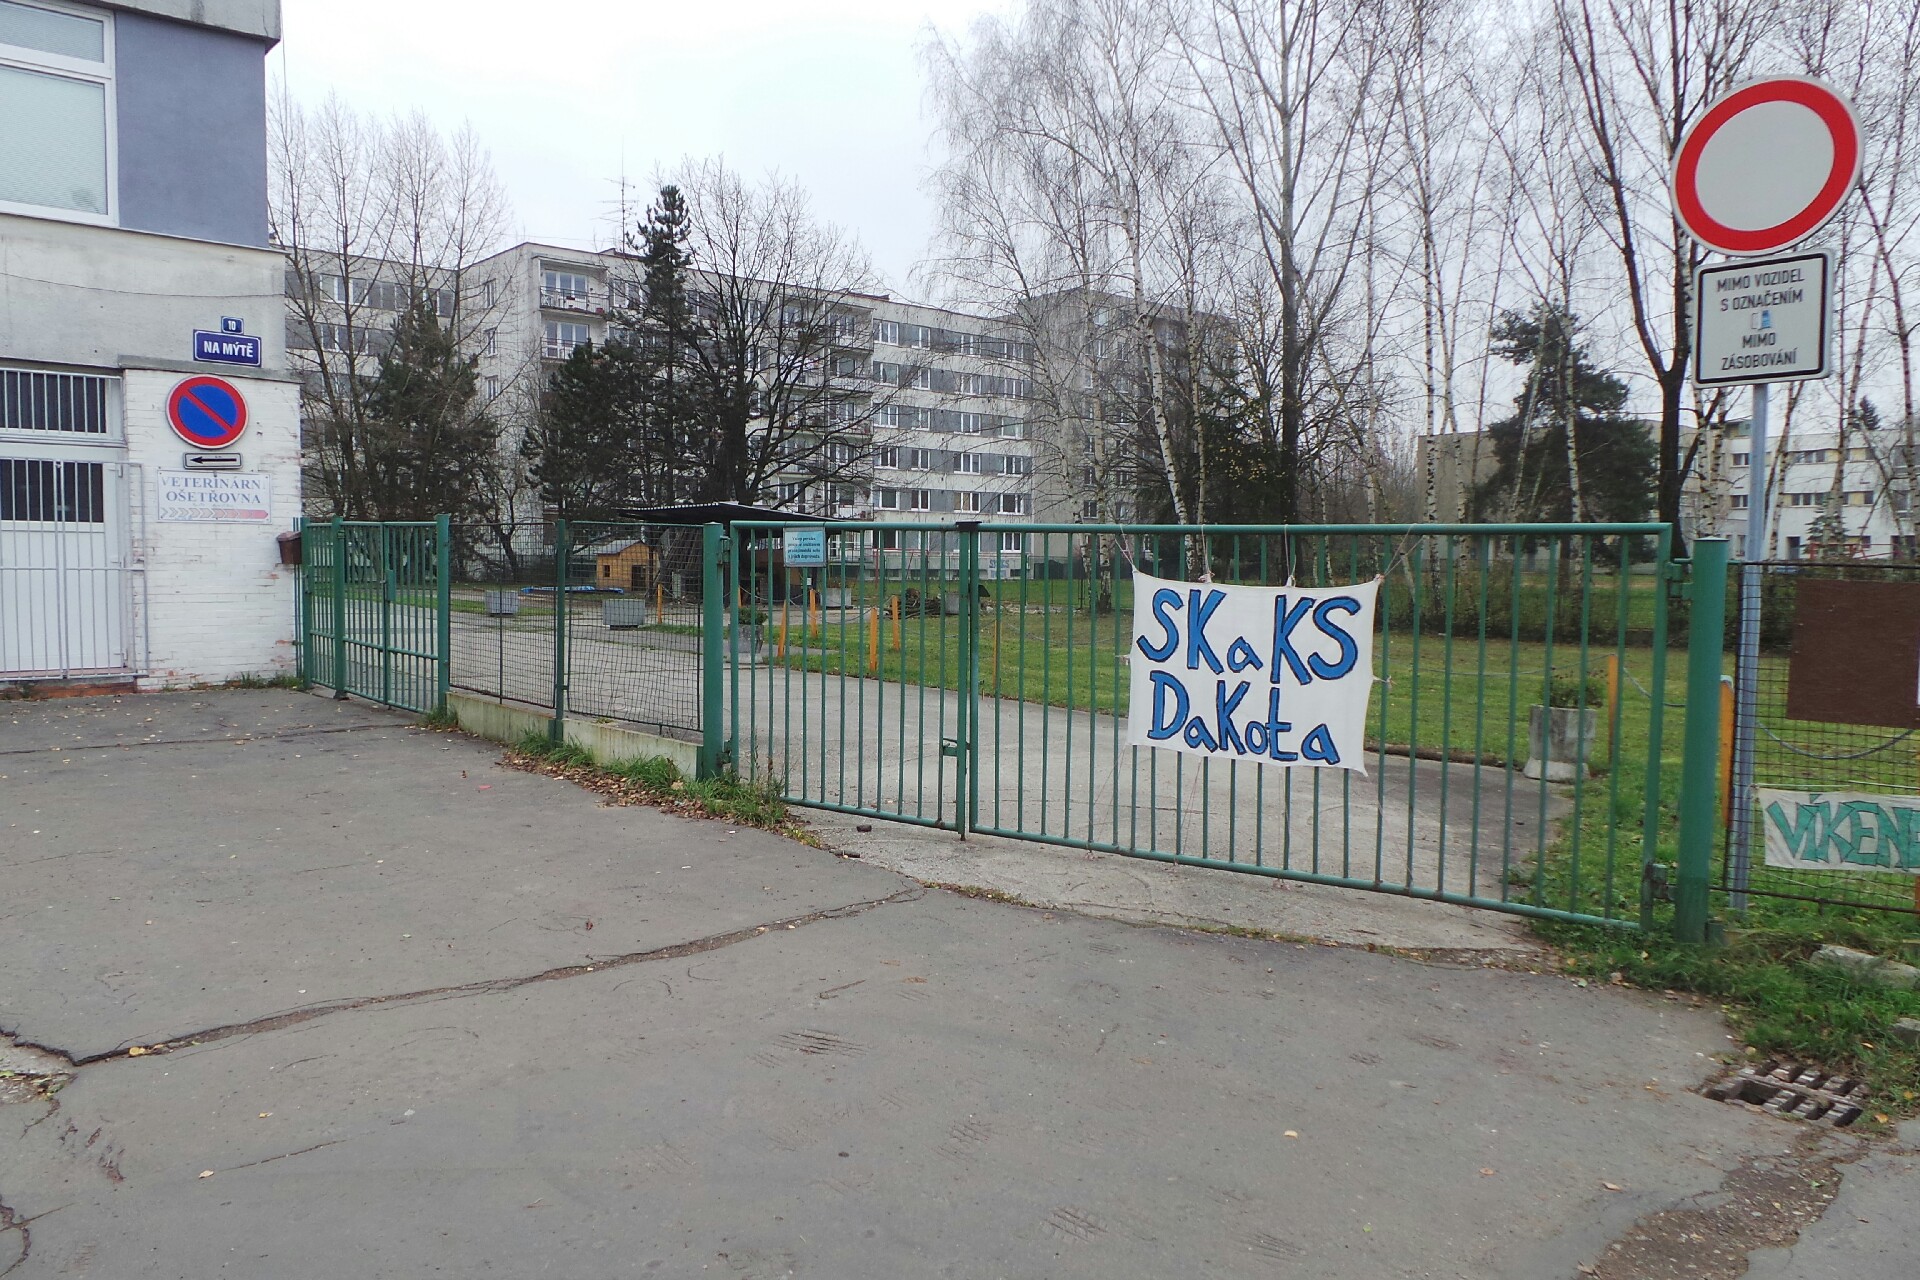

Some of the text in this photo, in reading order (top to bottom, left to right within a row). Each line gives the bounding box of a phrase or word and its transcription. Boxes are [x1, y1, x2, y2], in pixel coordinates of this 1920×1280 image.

[1717, 268, 1805, 292] MIMO VOZIDEL
[1721, 287, 1803, 312] S OZNAČENÍM
[228, 320, 237, 331] 10
[203, 340, 254, 358] NA MÝTĚ
[1742, 332, 1776, 349] MIMO
[1721, 348, 1798, 370] ZÁSOBOVÁNÍ
[166, 488, 261, 504] OŠETŘOVNA
